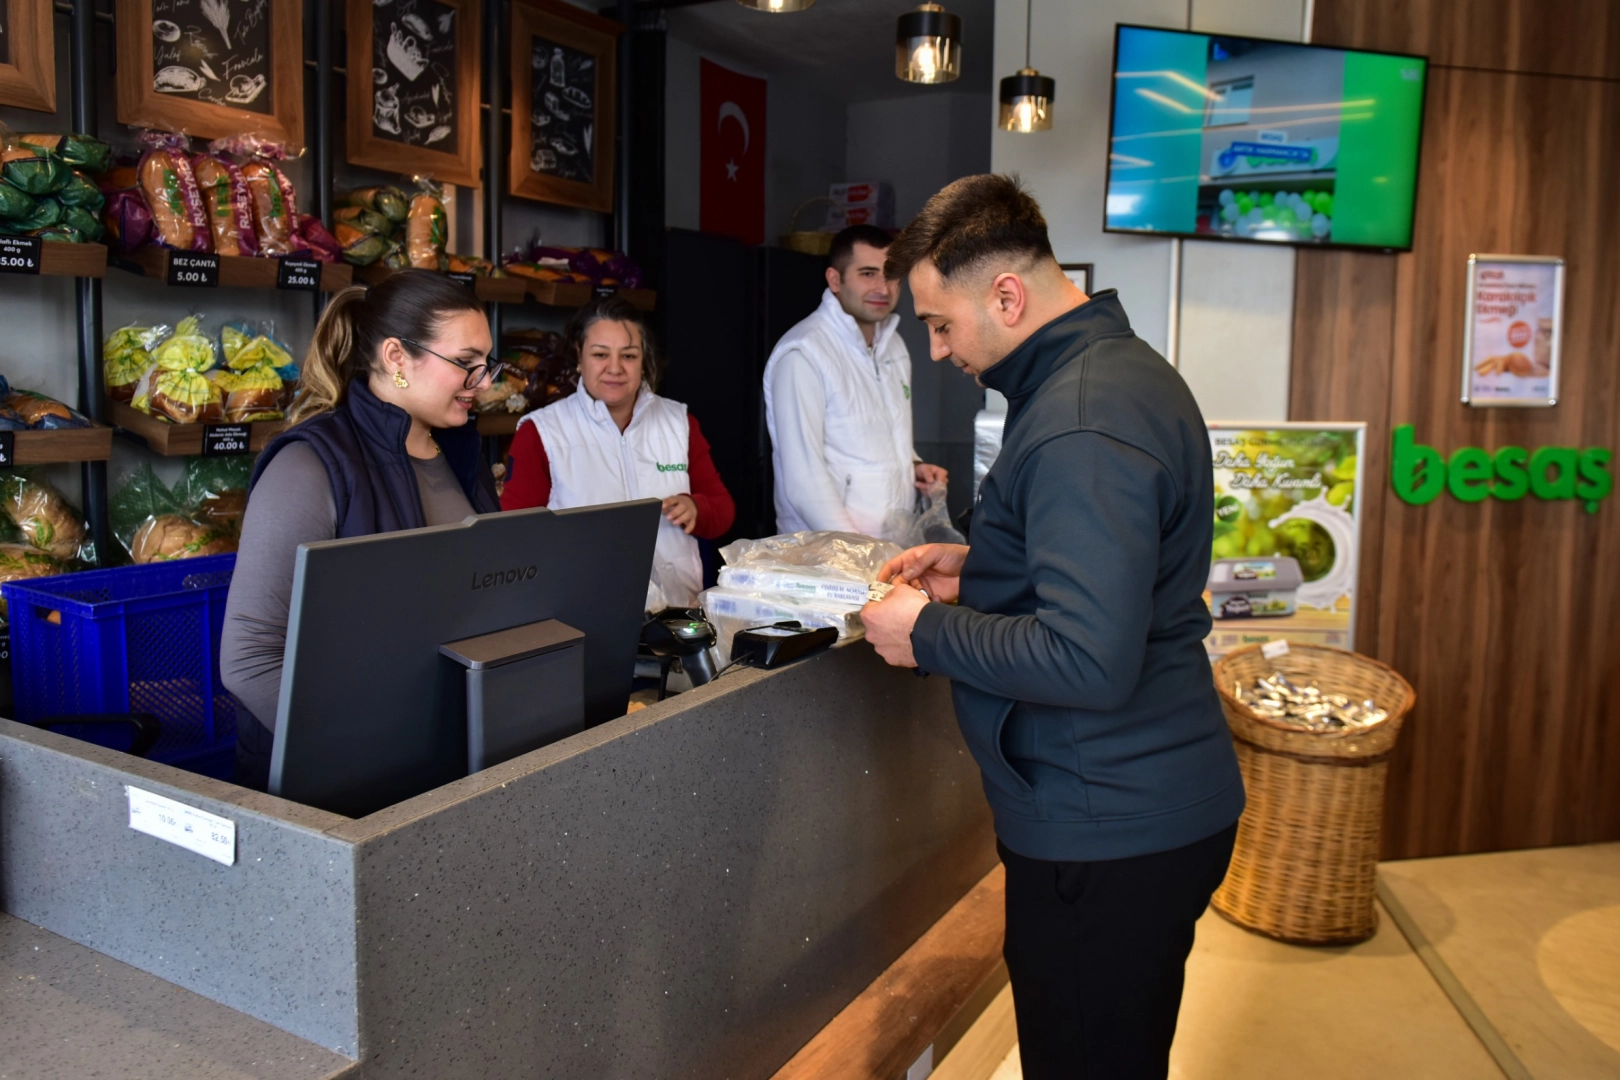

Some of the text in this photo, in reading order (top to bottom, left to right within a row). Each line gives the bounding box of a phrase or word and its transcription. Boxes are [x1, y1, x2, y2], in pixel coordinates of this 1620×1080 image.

[12, 239, 32, 247] Ekmek
[0, 256, 25, 267] 5.00
[173, 257, 216, 268] BEZ ÇANTA
[177, 271, 199, 282] 5.00
[287, 275, 309, 285] 25.00
[213, 441, 238, 450] 40.00
[1213, 450, 1252, 468] Daha
[1391, 423, 1613, 514] besaş
[1229, 471, 1269, 489] Daha
[471, 565, 538, 591] Lenovo
